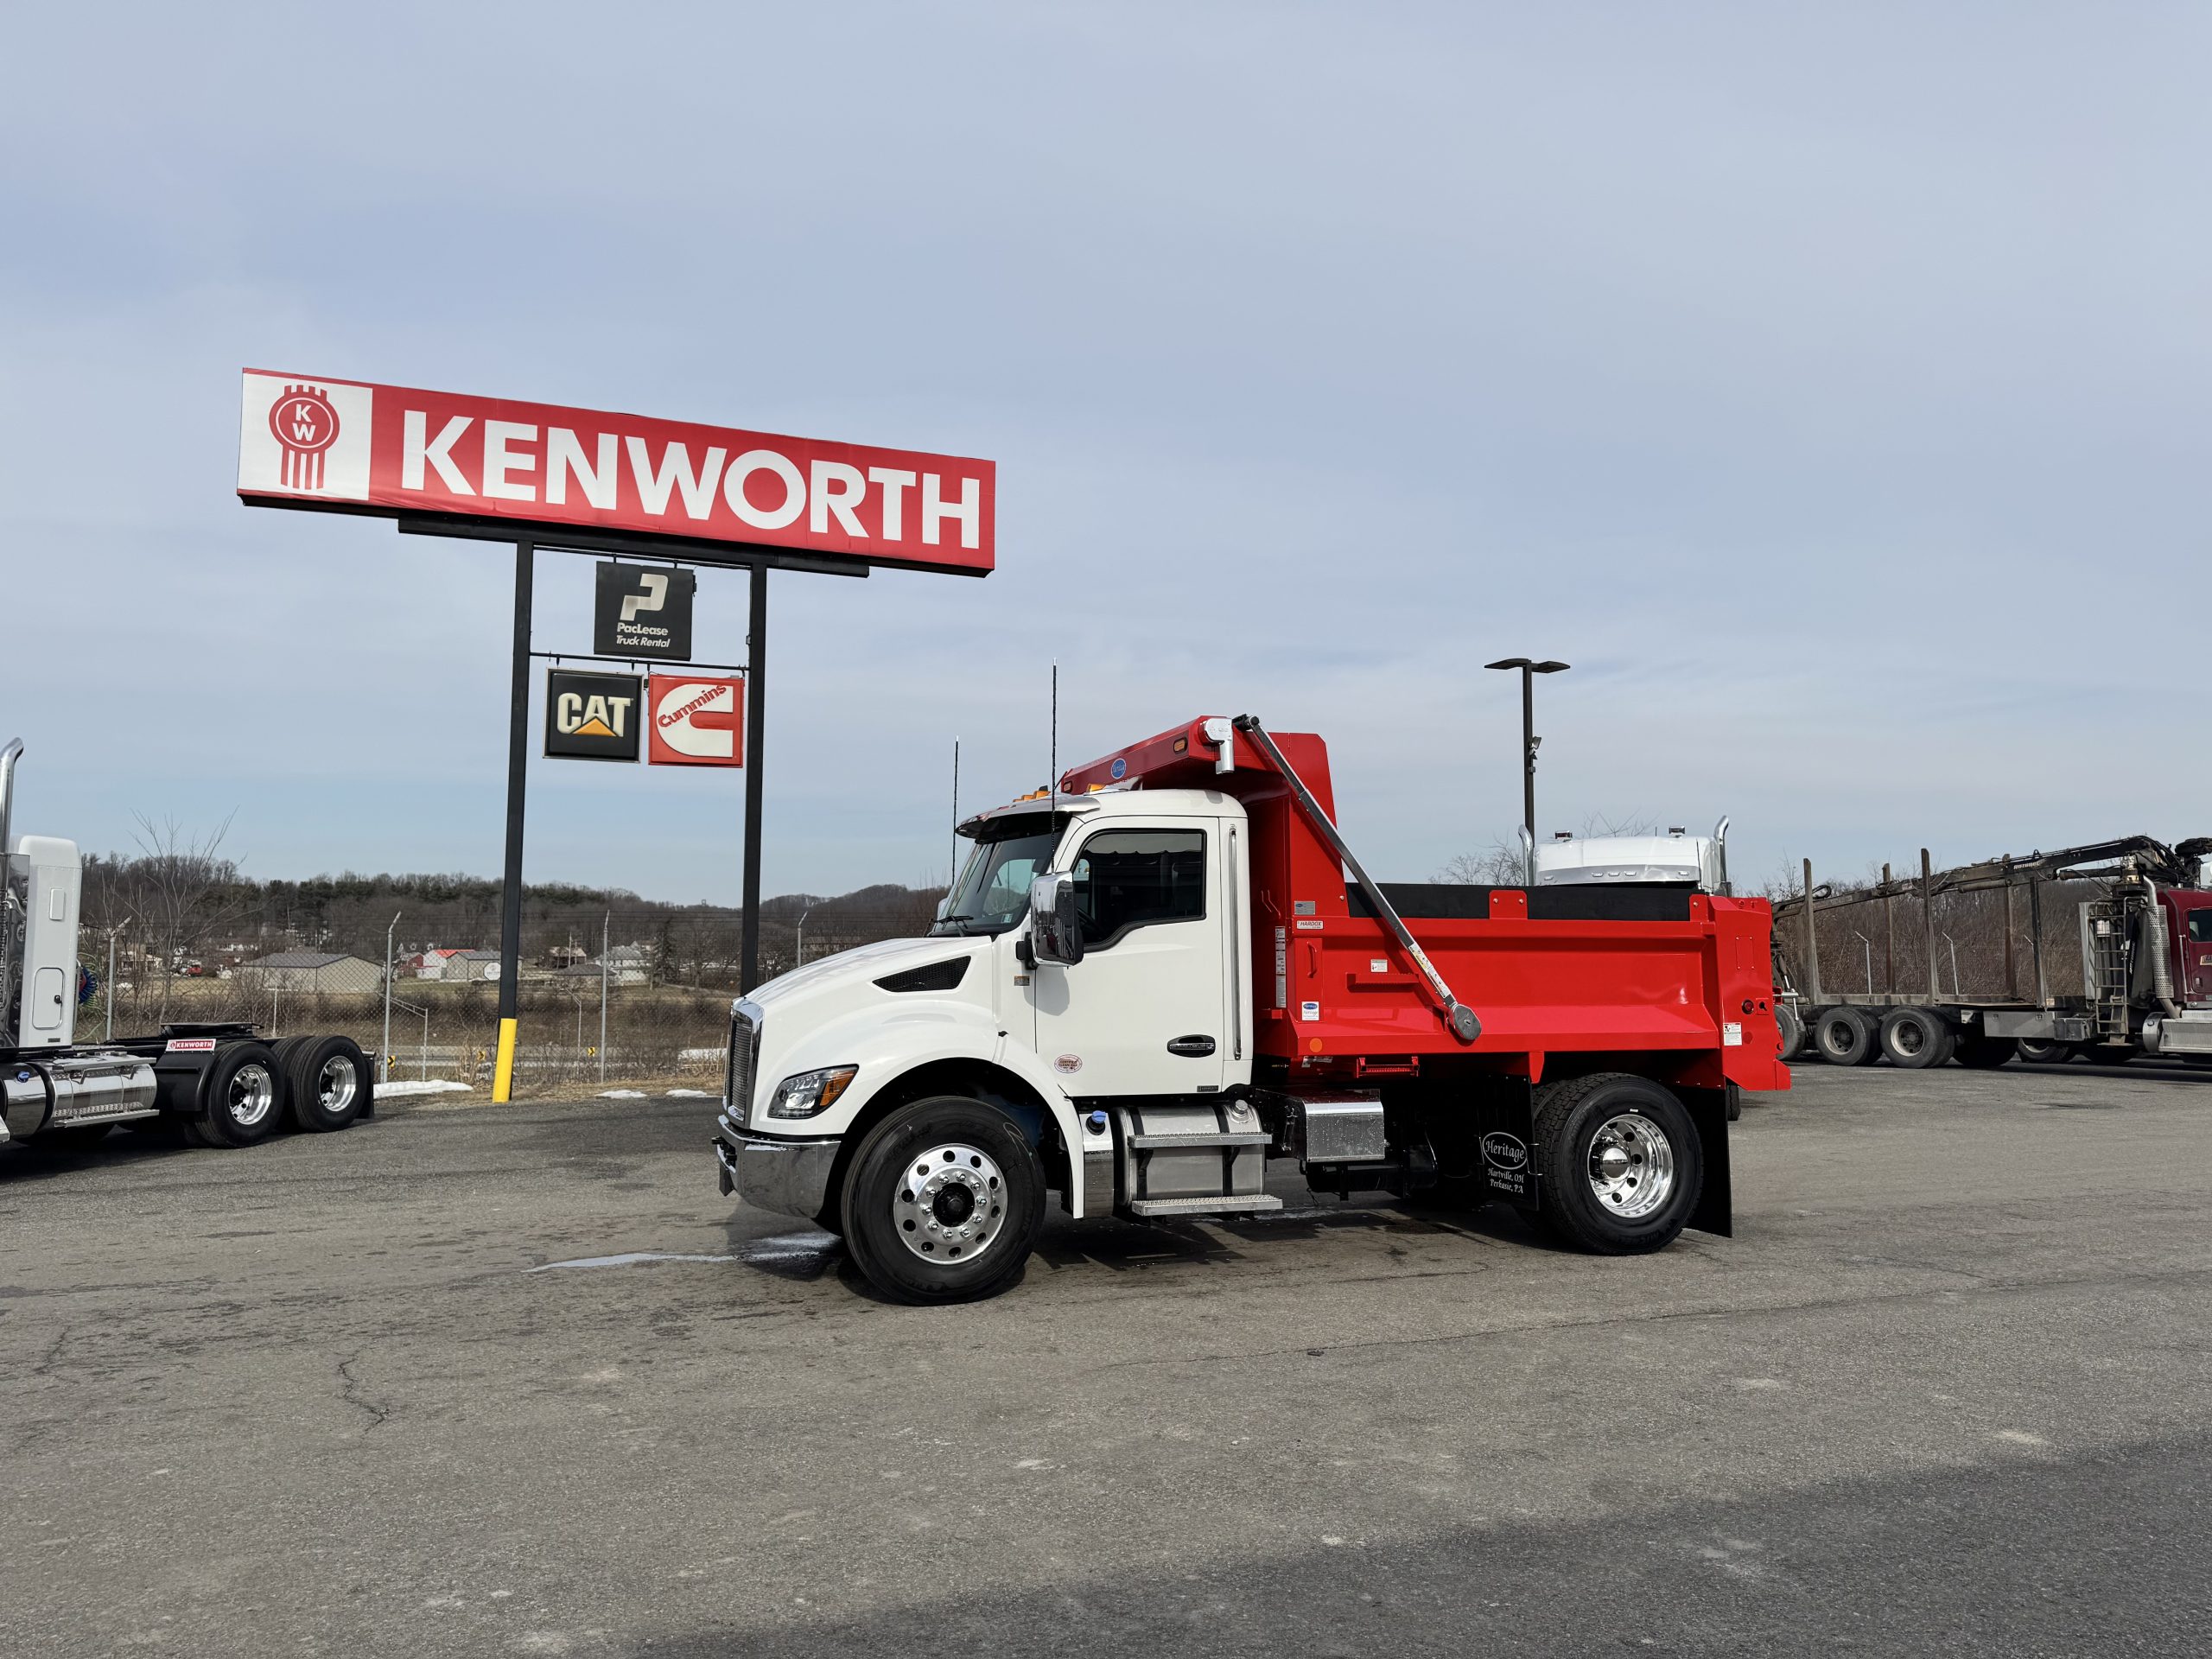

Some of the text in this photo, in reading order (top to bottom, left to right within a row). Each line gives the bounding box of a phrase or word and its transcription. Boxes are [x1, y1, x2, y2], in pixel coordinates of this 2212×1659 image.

[296, 404, 313, 423] K
[292, 423, 316, 442] W
[402, 410, 981, 550] KENWORTH
[616, 622, 669, 636] PacLease
[616, 635, 671, 648] Truck Rental
[557, 692, 631, 737] CAT
[658, 683, 728, 728] Cummins
[1485, 1140, 1525, 1163] Heritage
[1487, 1167, 1525, 1184] Hartville, OH
[1490, 1178, 1523, 1194] Perkasie, PA
